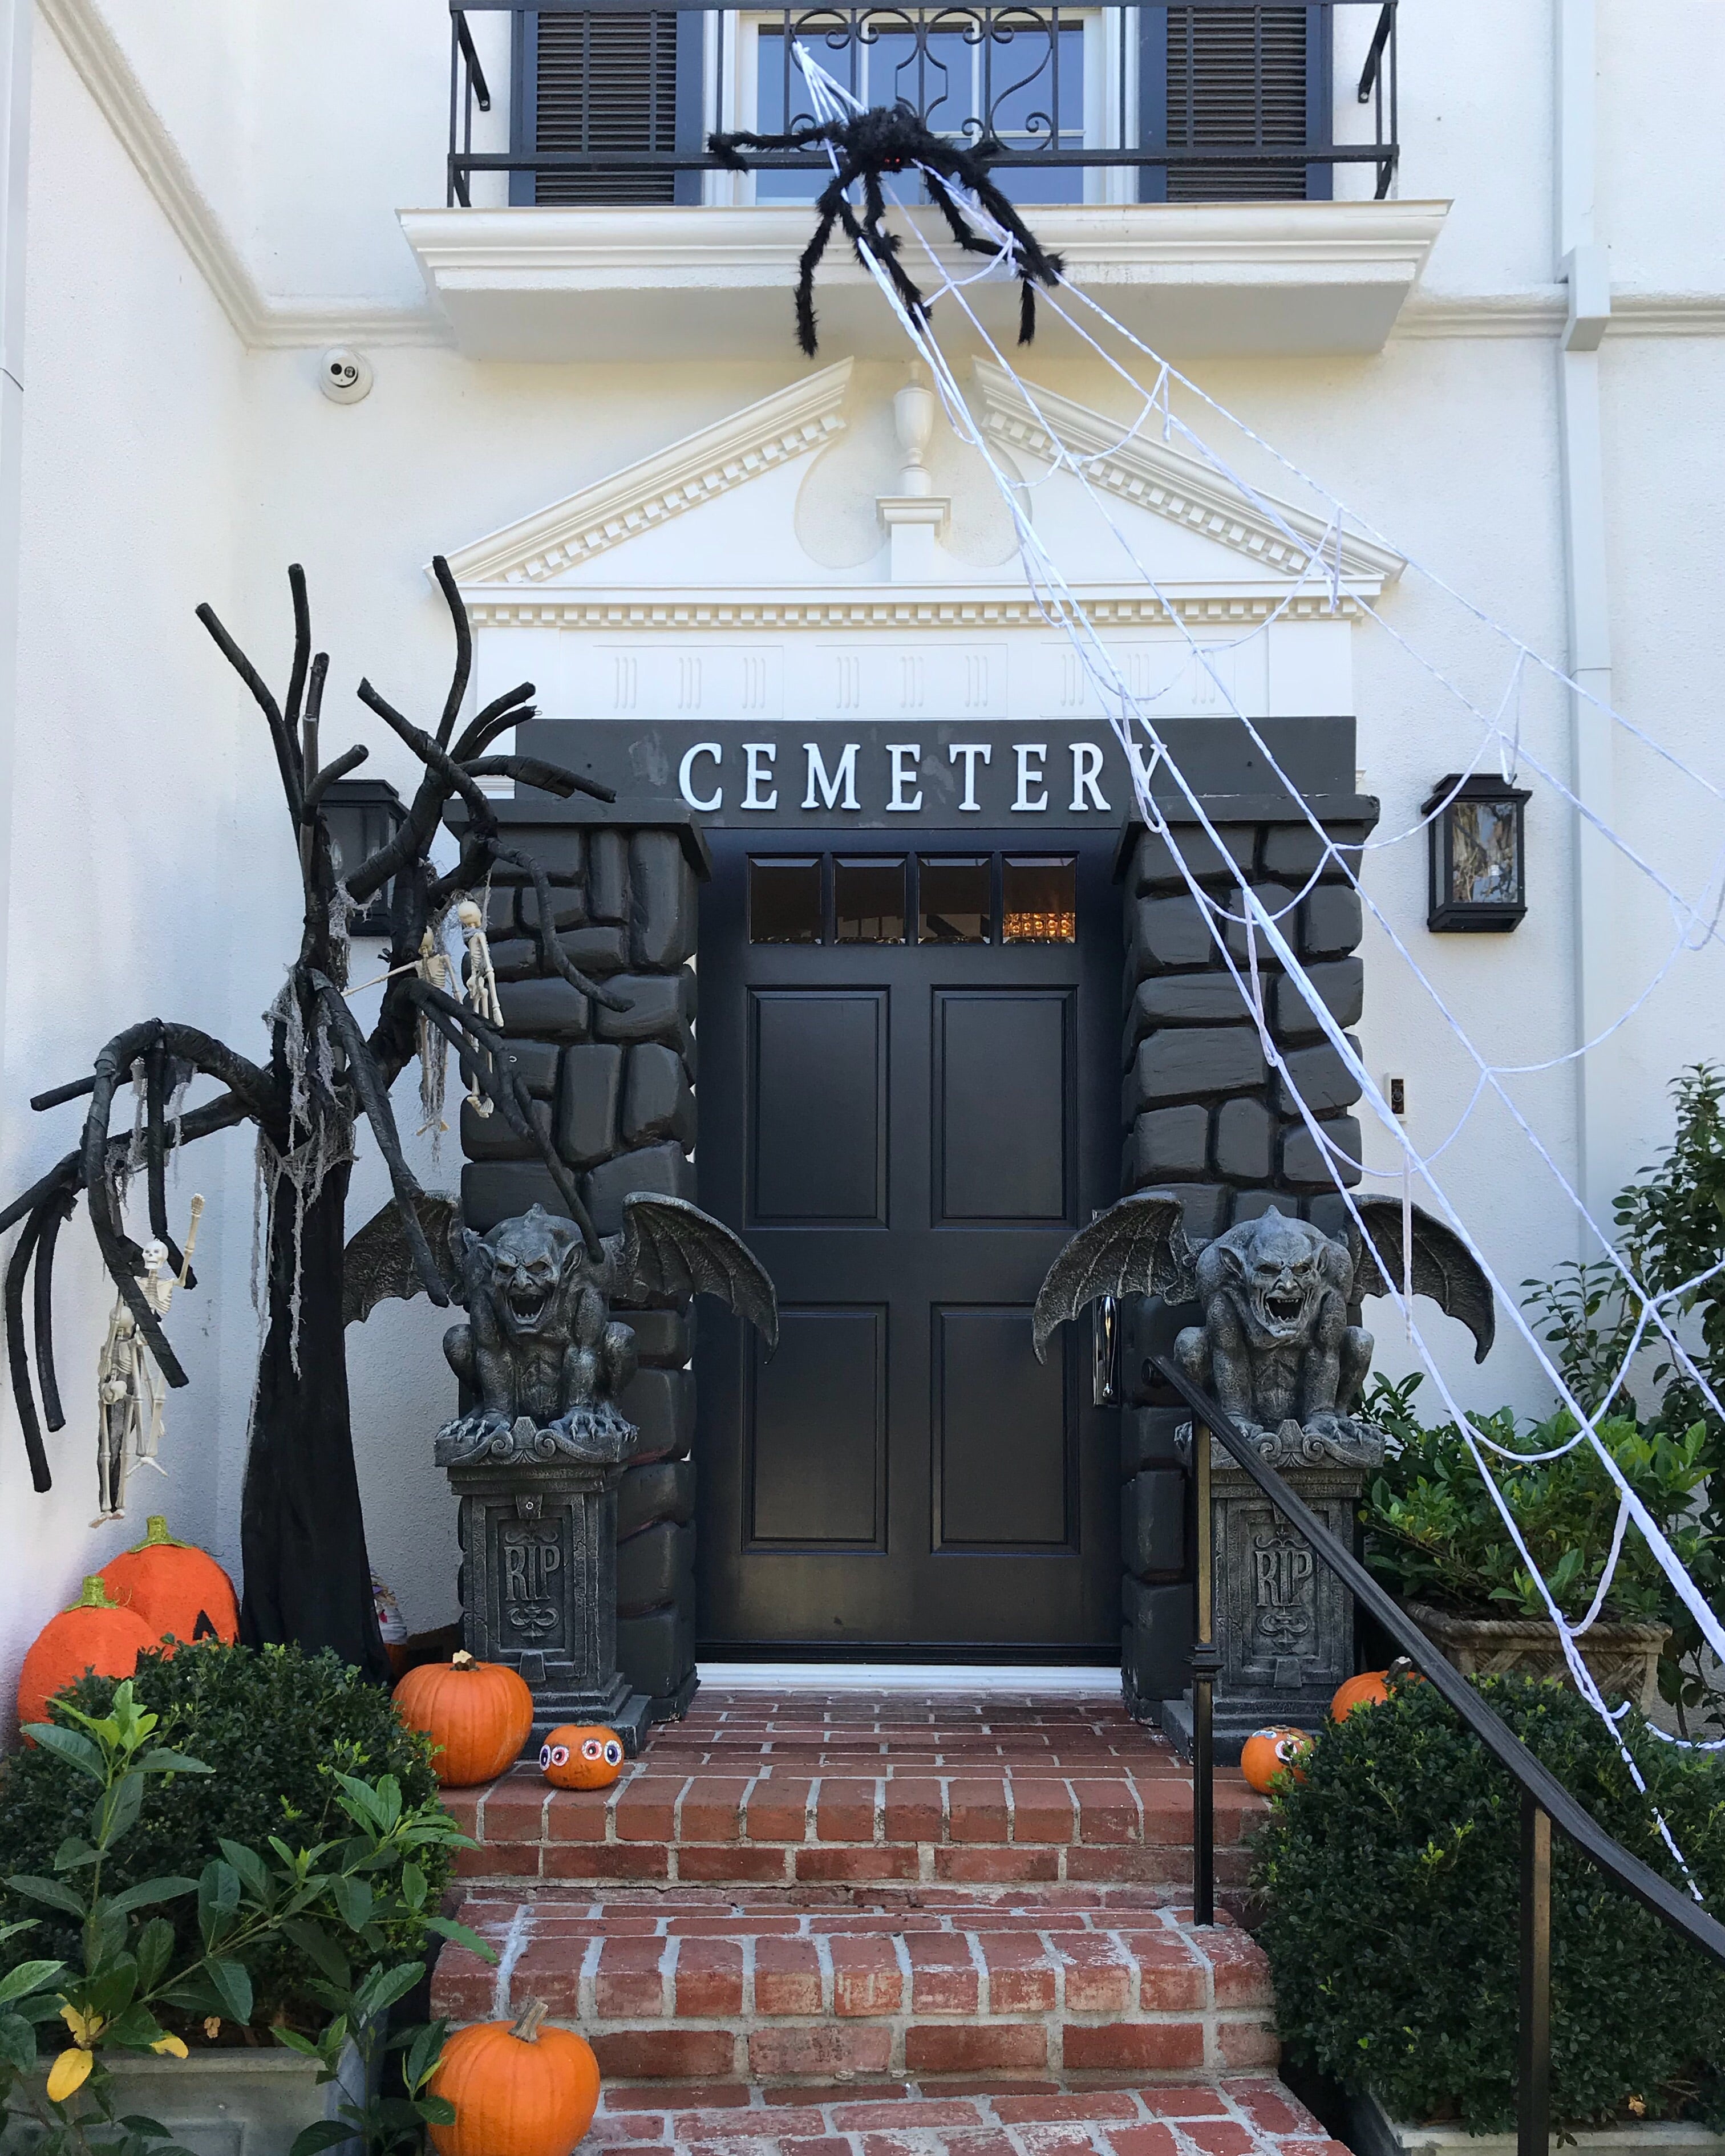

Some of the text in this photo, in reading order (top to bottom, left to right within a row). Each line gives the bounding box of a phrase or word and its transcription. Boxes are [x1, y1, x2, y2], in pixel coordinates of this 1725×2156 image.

[679, 743, 1168, 811] CEMETERY
[504, 1545, 560, 1601] RIP
[1255, 1550, 1313, 1607] RIP
